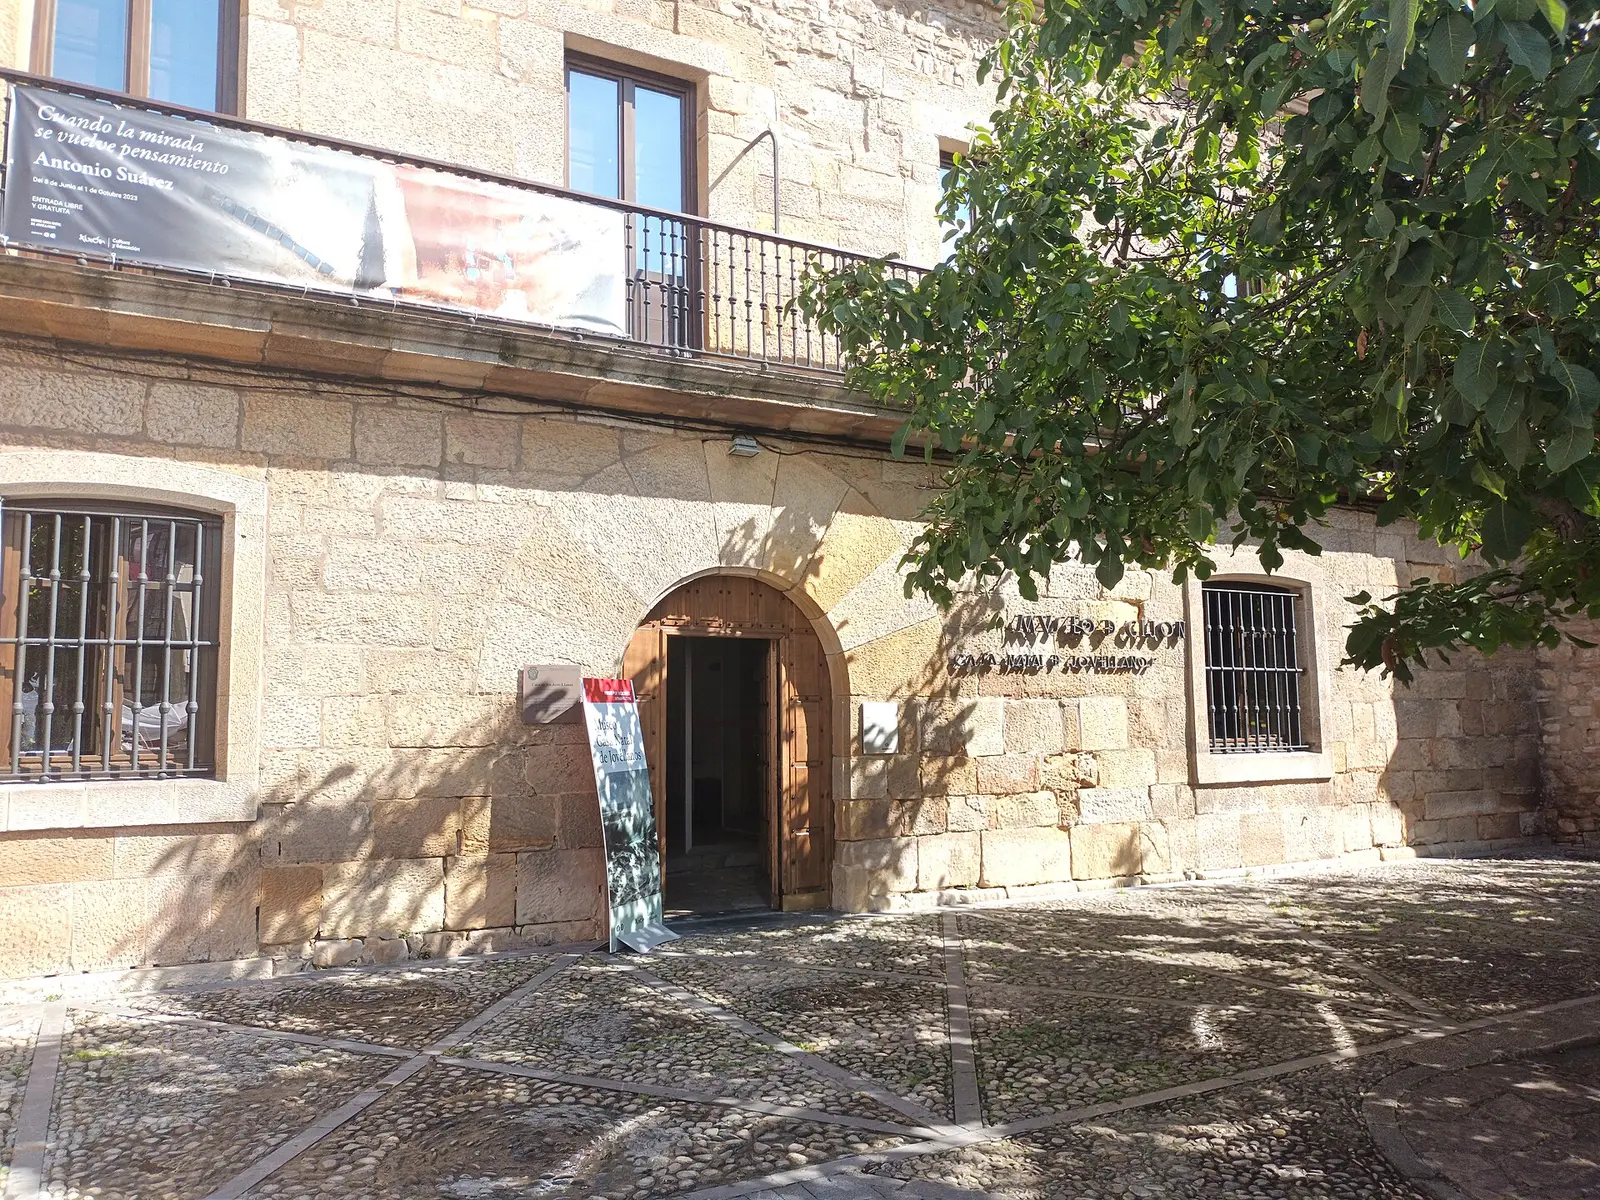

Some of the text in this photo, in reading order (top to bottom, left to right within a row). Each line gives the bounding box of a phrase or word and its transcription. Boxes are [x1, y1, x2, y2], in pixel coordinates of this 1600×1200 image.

[38, 105, 204, 153] Cuando la mirada
[35, 127, 229, 175] se vuelve pensamiento
[33, 151, 174, 191] Antonio Suárez
[32, 176, 43, 184] Del
[59, 182, 76, 190] Junio
[98, 188, 122, 199] Octubre
[122, 193, 138, 201] 2023
[32, 195, 83, 211] ENTRADA LIBRE
[37, 203, 71, 215] GRATUITA
[600, 750, 608, 764] de
